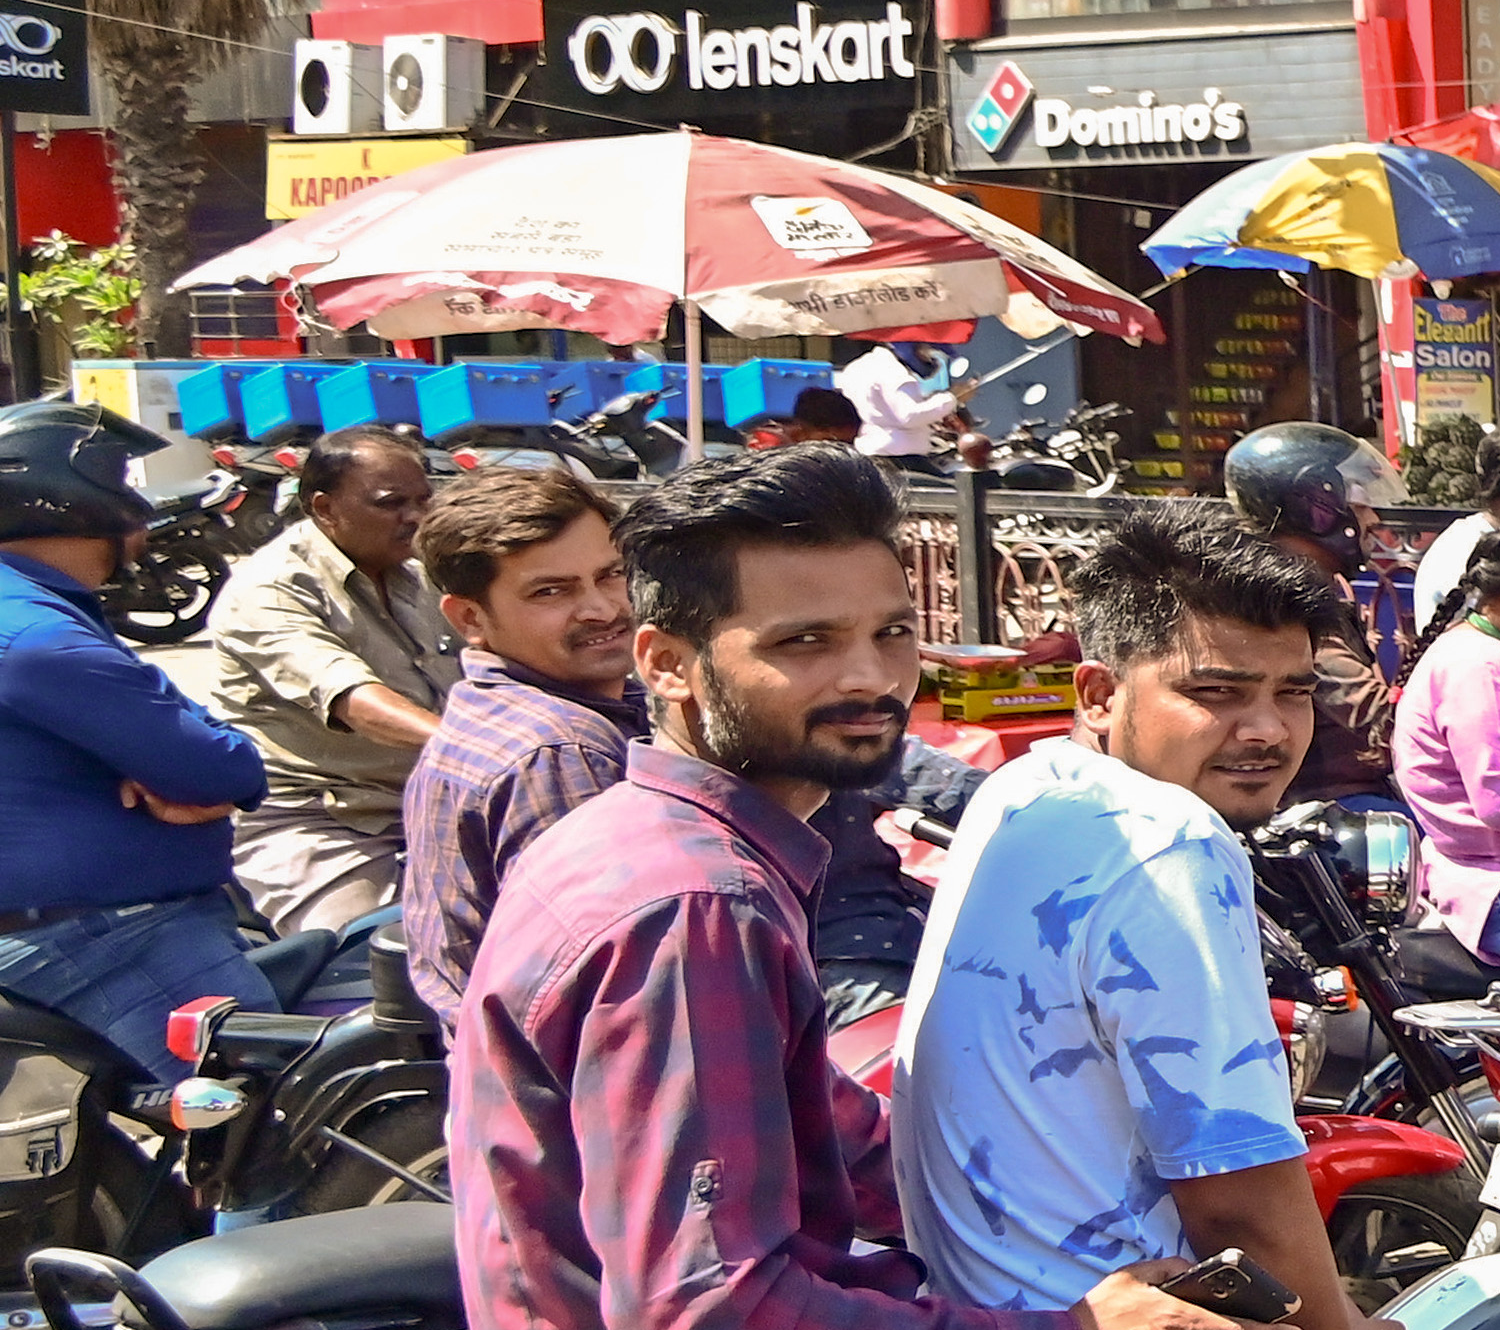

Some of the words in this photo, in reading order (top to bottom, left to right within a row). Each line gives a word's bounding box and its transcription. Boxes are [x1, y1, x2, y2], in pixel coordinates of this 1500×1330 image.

[685, 0, 914, 92] lenskart
[1034, 88, 1248, 149] Domino's
[1416, 343, 1491, 369] Salon
